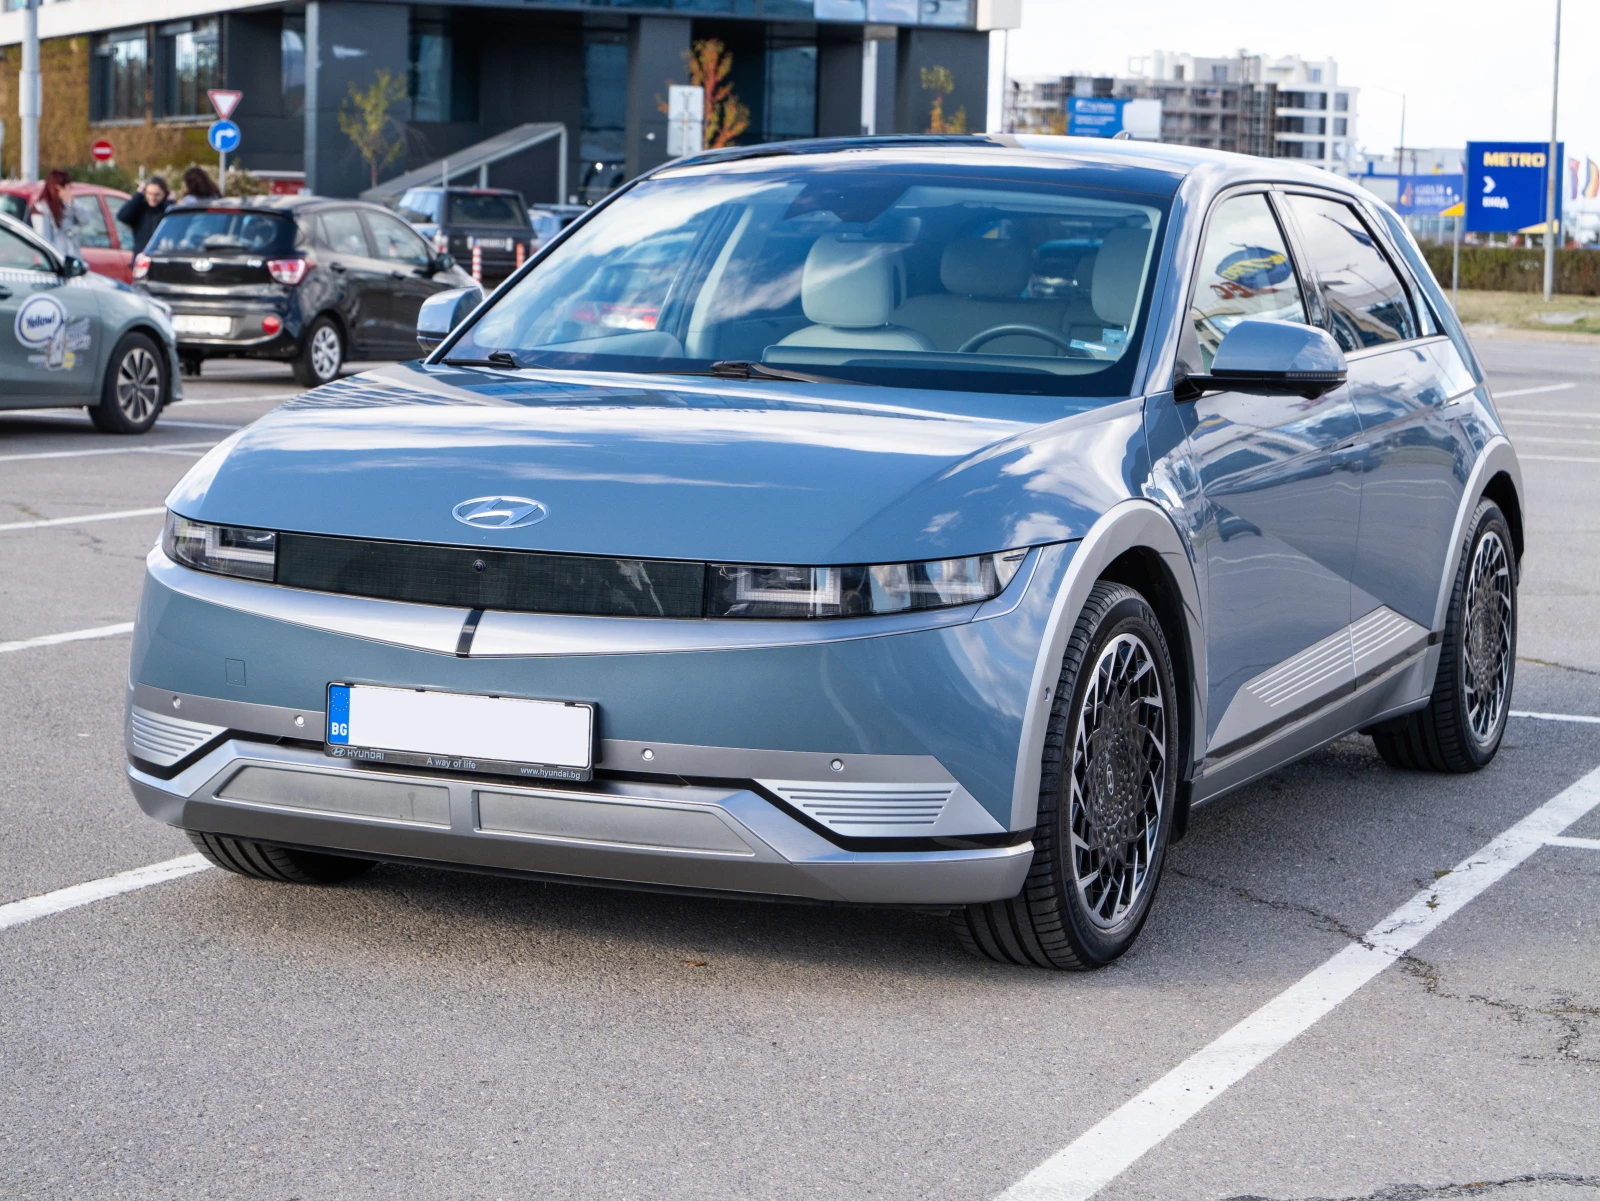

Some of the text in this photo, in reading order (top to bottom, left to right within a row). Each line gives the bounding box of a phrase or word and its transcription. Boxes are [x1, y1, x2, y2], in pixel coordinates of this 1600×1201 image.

[1483, 152, 1546, 168] METRO
[331, 722, 348, 736] BG
[347, 749, 385, 760] HYUNDAI
[426, 756, 476, 769] A way of life
[520, 767, 581, 780] www.hyundai.bg
